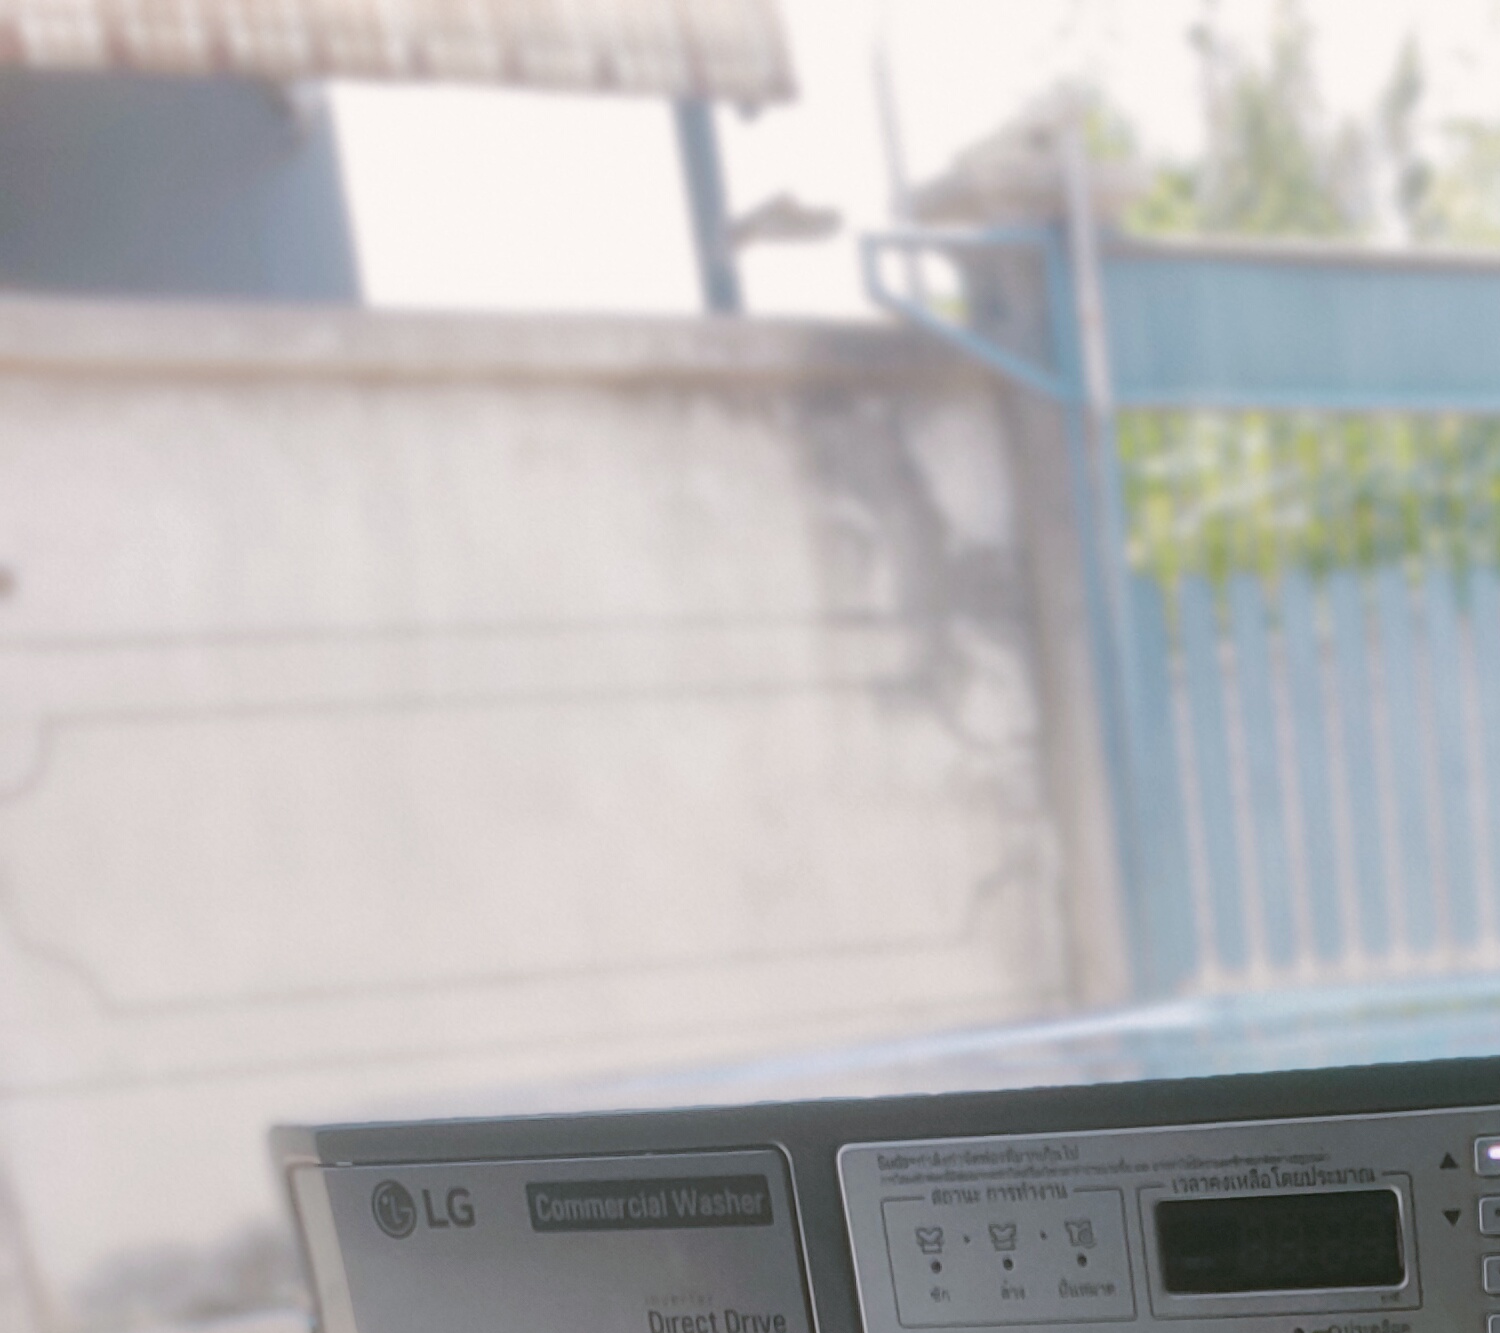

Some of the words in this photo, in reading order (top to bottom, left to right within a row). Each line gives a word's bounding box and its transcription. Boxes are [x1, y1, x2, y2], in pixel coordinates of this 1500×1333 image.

[424, 1187, 476, 1229] LG
[535, 1189, 668, 1223] Commercial
[672, 1187, 764, 1217] Washer
